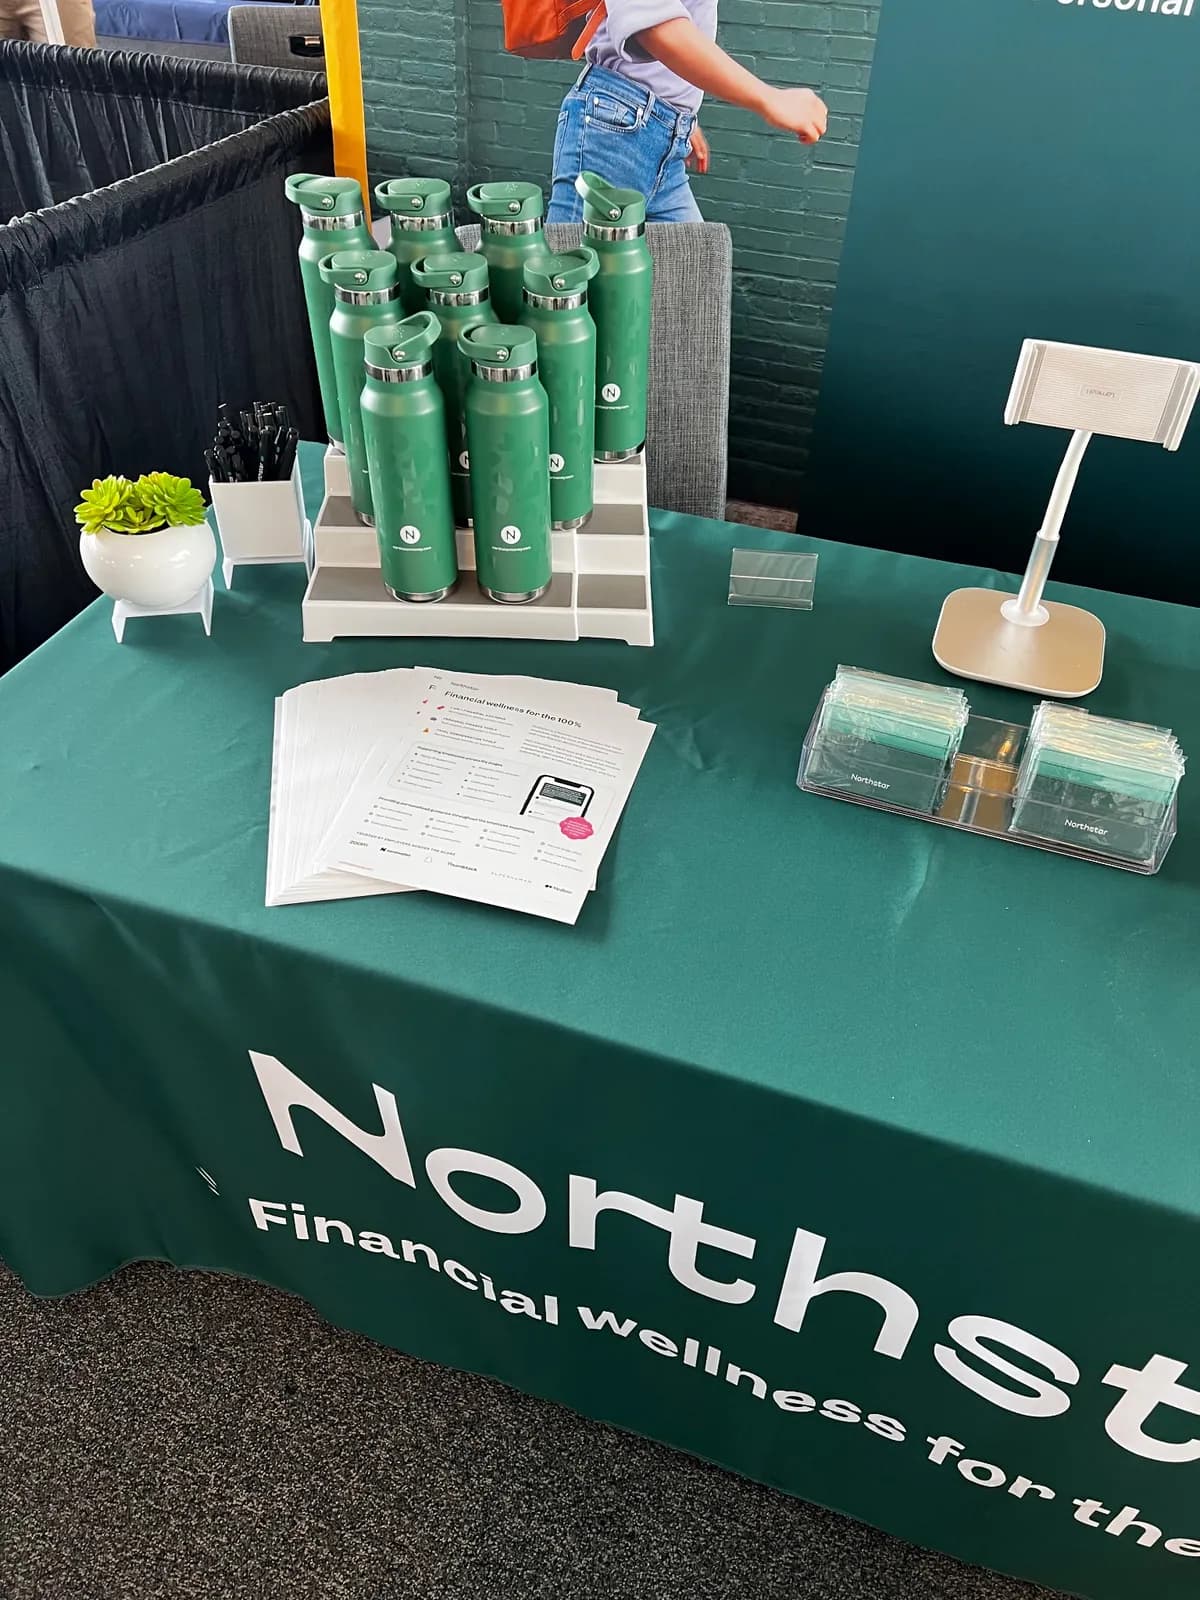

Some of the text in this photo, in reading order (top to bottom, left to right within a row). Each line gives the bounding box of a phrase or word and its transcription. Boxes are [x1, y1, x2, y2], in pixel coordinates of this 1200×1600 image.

[444, 690, 486, 705] Financial
[486, 700, 525, 713] wellness
[525, 709, 541, 717] for
[541, 713, 556, 721] the
[557, 717, 583, 728] 100%
[850, 773, 891, 790] Northstar
[1064, 819, 1108, 836] Northstar
[249, 1050, 1200, 1463] Northst
[249, 1198, 1200, 1557] Financial wellness for the
